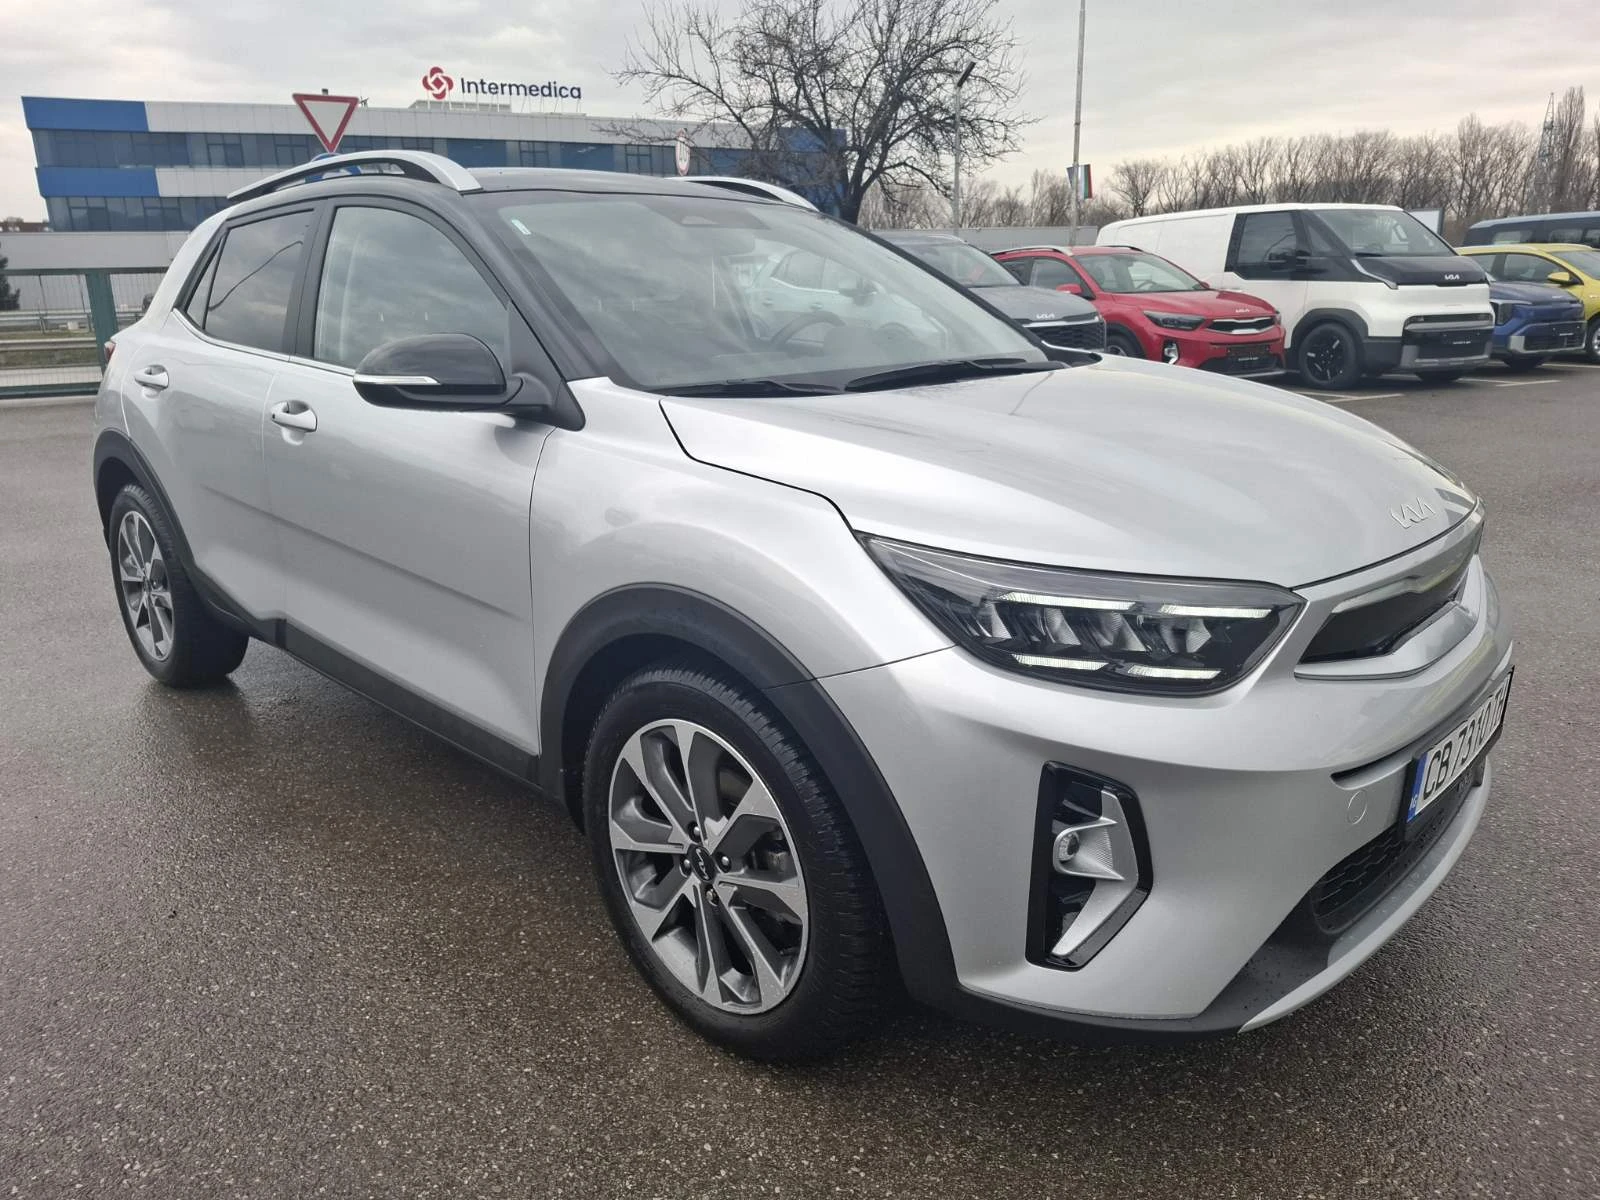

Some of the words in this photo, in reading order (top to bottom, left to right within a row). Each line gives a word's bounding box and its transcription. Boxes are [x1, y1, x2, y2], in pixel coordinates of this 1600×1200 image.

[461, 77, 582, 99] Intermedica
[1389, 496, 1436, 529] KIA
[1423, 740, 1453, 800] CB
